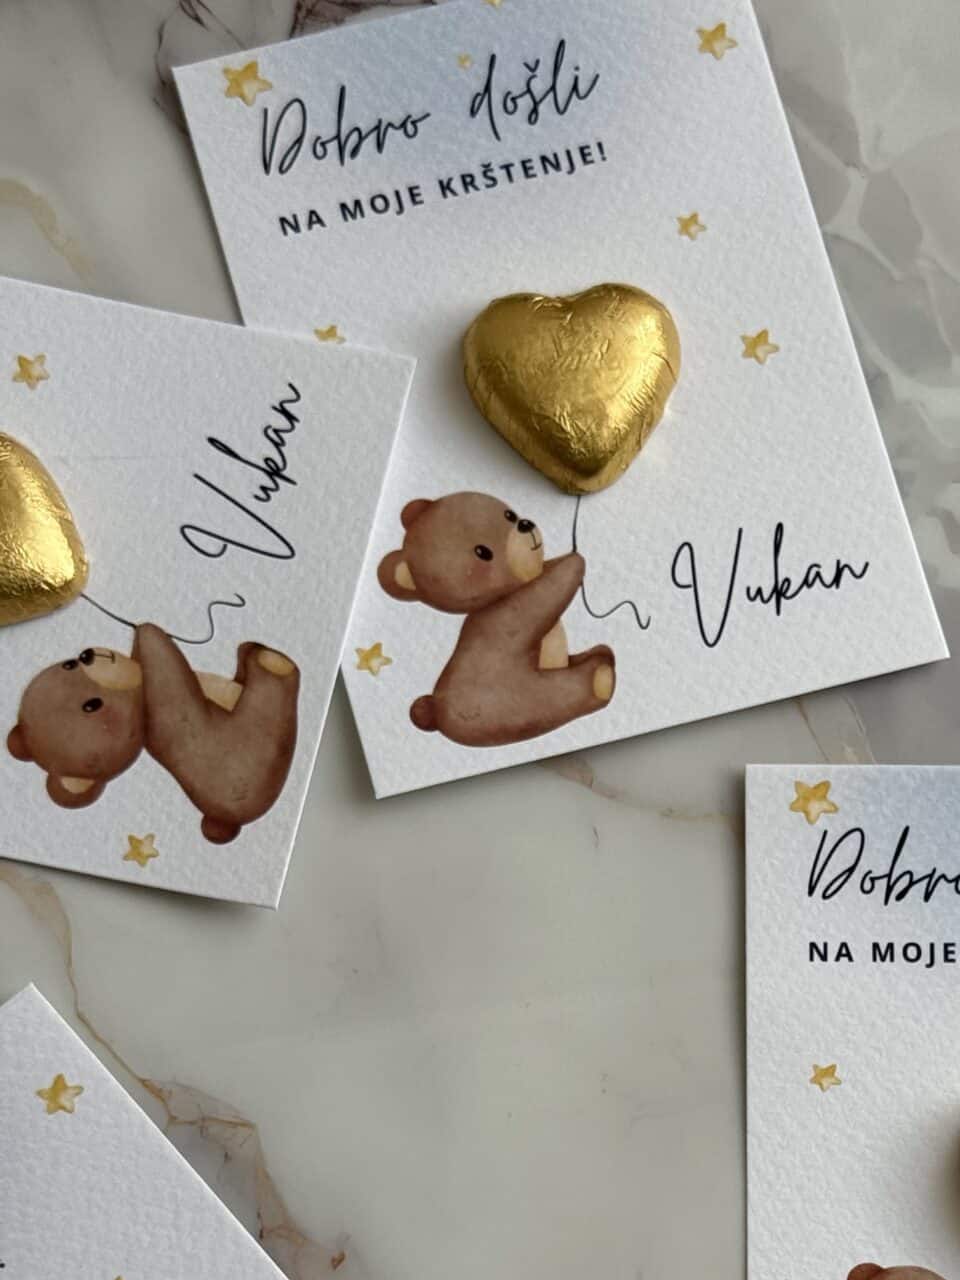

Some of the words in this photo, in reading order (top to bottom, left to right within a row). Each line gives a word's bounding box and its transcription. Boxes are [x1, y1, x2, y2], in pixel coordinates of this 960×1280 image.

[260, 84, 432, 177] Dobro
[468, 37, 601, 141] došli
[277, 208, 327, 237] NA
[338, 184, 425, 223] MOJE
[437, 140, 607, 200] KRŠTENJE!
[179, 381, 302, 561] Vukan
[670, 521, 870, 649] Vukan
[808, 941, 855, 963] NA
[871, 941, 957, 969] MOJE
